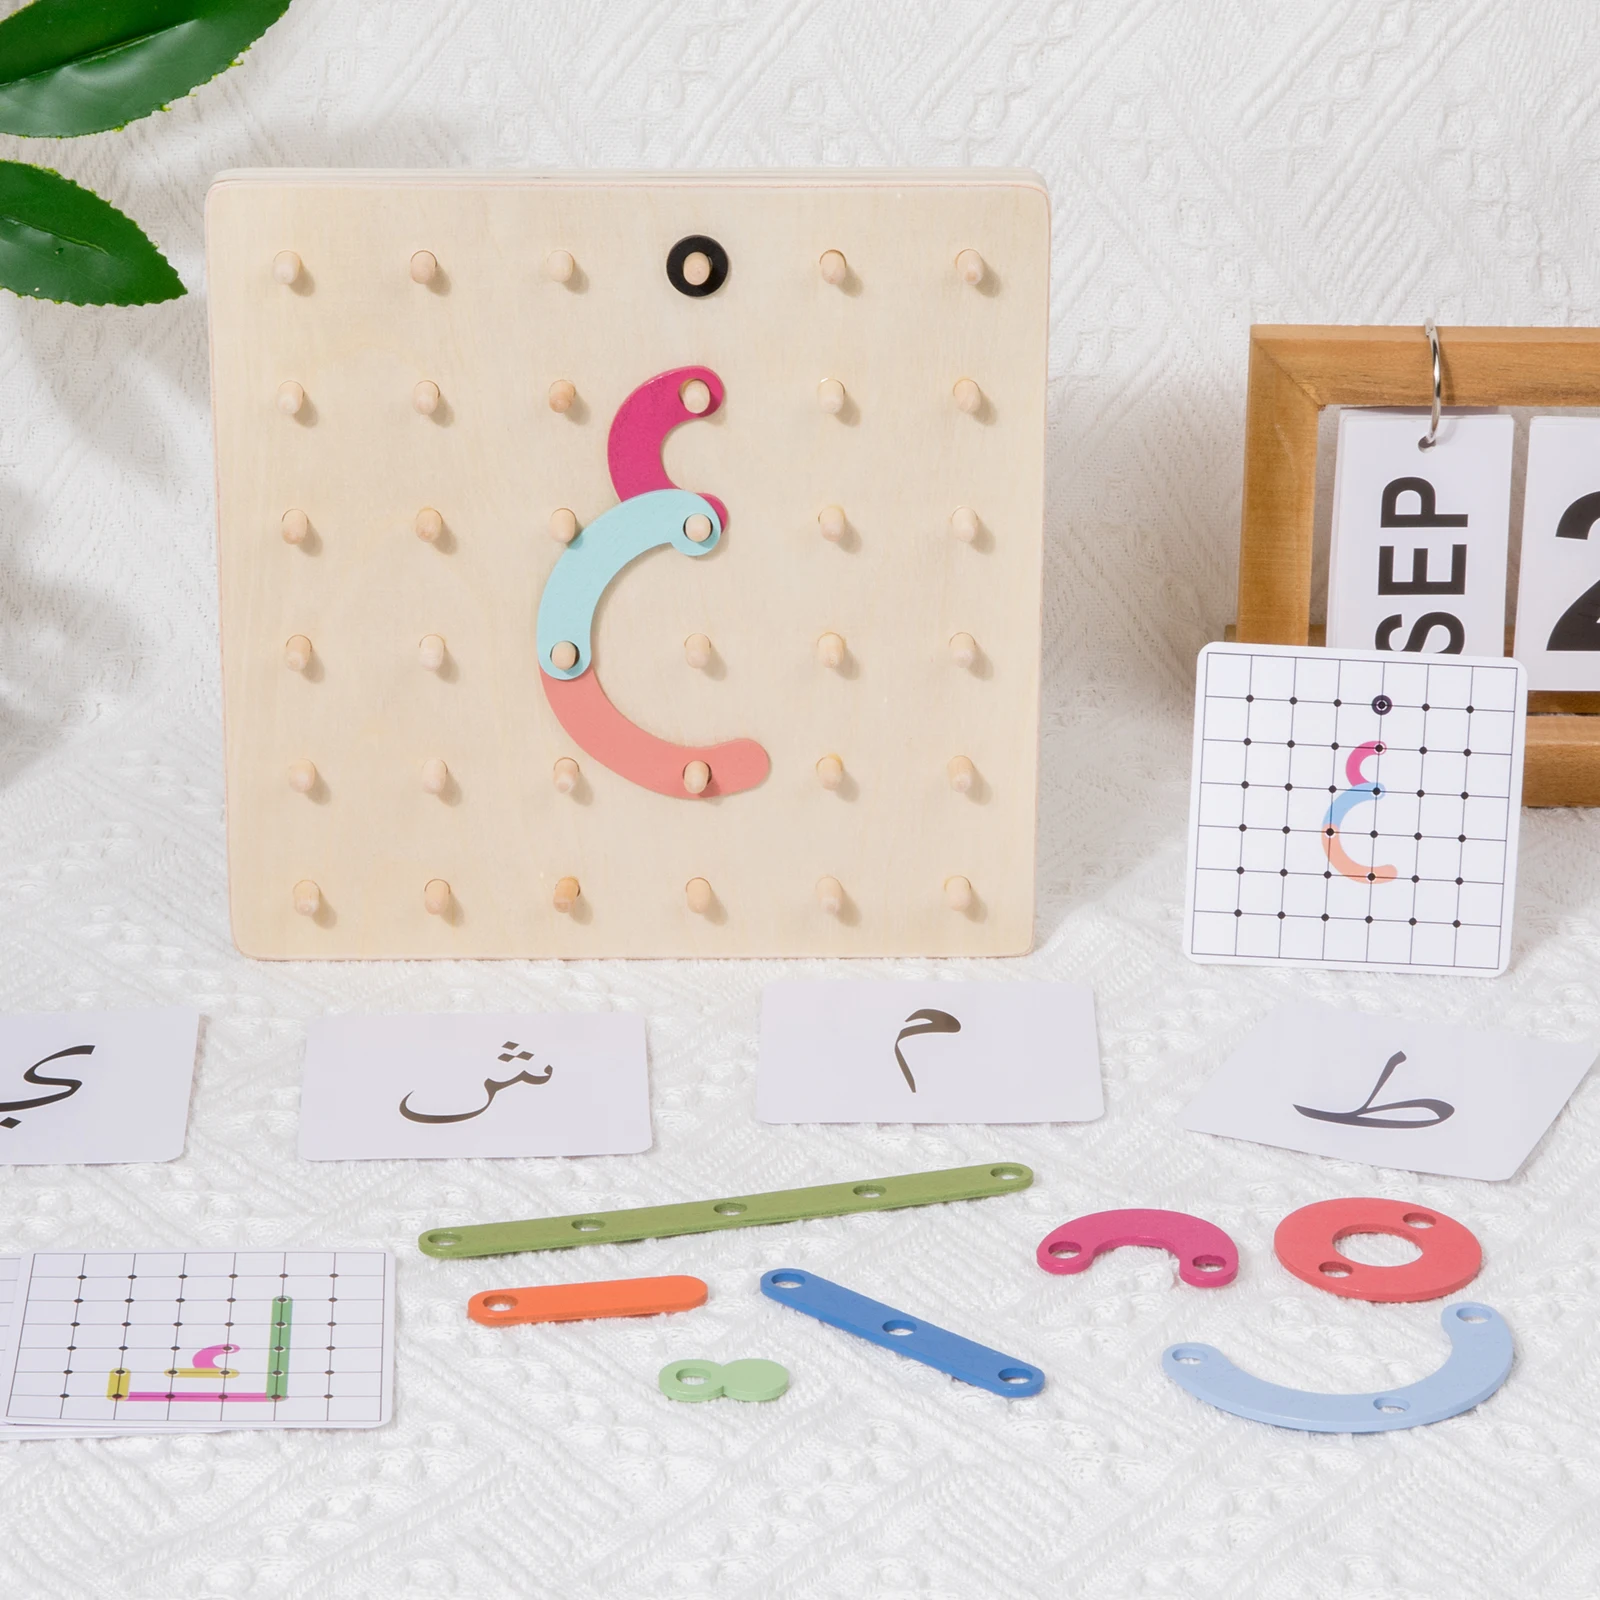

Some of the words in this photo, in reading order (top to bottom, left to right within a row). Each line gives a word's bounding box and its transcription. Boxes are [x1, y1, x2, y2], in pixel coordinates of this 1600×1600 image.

[1375, 476, 1468, 655] SEP
[399, 1041, 553, 1124] ش
[894, 1008, 962, 1093] م
[1293, 1050, 1455, 1129] ط
